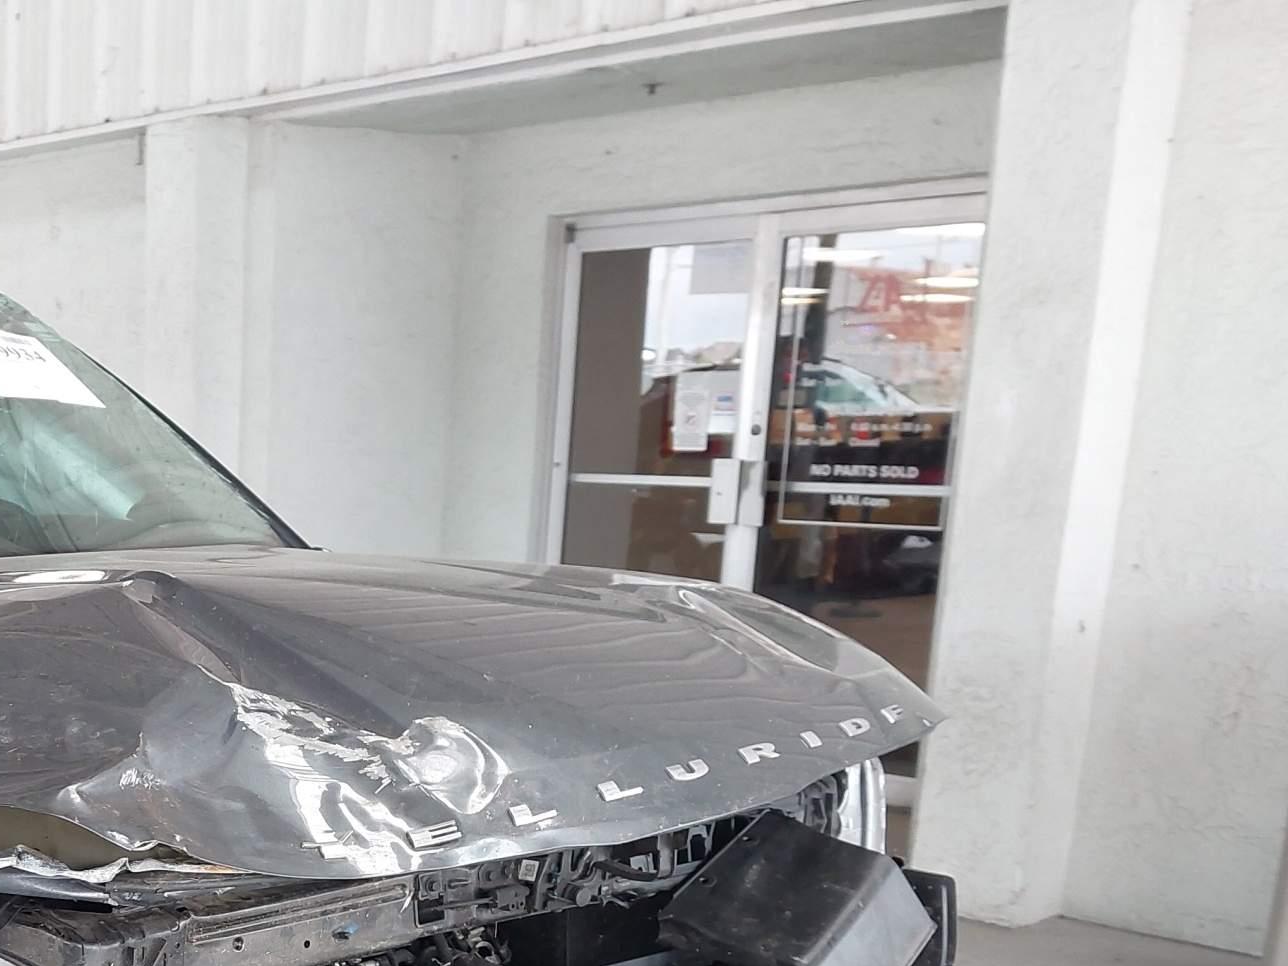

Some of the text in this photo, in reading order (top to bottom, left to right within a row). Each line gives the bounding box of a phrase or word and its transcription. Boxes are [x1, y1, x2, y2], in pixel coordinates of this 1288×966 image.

[809, 463, 920, 479] NO PARTS SOLD
